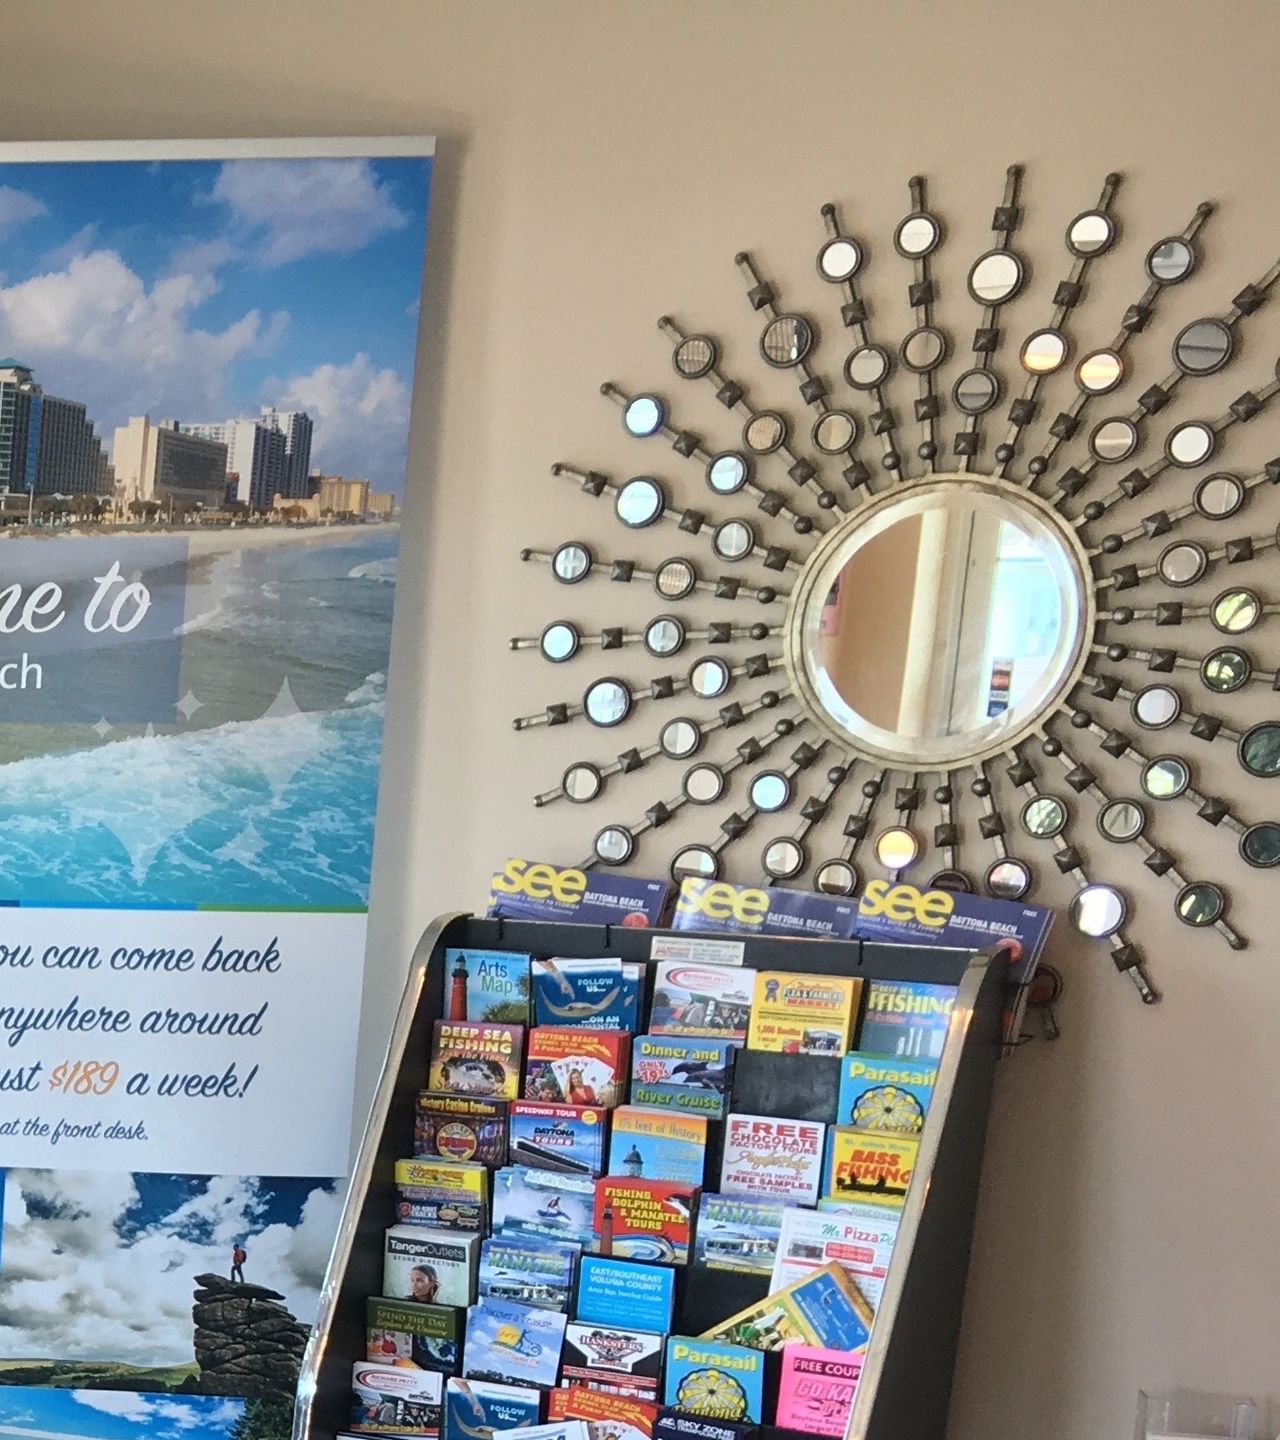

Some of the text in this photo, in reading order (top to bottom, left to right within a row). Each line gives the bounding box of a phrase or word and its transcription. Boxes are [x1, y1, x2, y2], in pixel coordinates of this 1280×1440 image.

[84, 560, 152, 633] to
[492, 858, 587, 904] see
[583, 891, 644, 907] DAYTONA BEACH
[677, 876, 770, 924] see
[858, 879, 955, 927] see
[767, 912, 833, 930] DAYTONA BEACH
[950, 915, 1018, 934] DAYTONA BEACH
[42, 945, 102, 969] can
[110, 947, 195, 971] come
[202, 935, 281, 972] back
[477, 960, 507, 977] Arts
[481, 976, 513, 995] Map
[577, 978, 614, 987] FOLLOW
[139, 1001, 268, 1035] around
[441, 1025, 513, 1042] DEEP SEA
[534, 1032, 599, 1045] DAYTONA BEACH
[440, 1038, 513, 1054] FISHING
[641, 1043, 719, 1061] Dinner and
[48, 1060, 120, 1095] $189
[126, 1072, 151, 1096] a
[157, 1062, 259, 1097] week!
[636, 1089, 721, 1109] River Cruise
[515, 1105, 554, 1116] SPEEDWAY
[555, 1108, 577, 1118] TOUR
[0, 1118, 20, 1136] at
[22, 1116, 49, 1137] the
[51, 1118, 102, 1145] front
[104, 1120, 149, 1141] desk.
[534, 1127, 575, 1137] DAYTONA
[730, 1120, 819, 1140] FREE
[534, 1136, 573, 1146] TOURS
[730, 1132, 818, 1149] CHOCOLATE
[730, 1140, 818, 1155] FACTORY TOURS
[850, 1149, 901, 1167] BASS
[736, 1169, 773, 1179] CHOCOLATE
[836, 1162, 912, 1184] FISHING
[726, 1174, 813, 1191] FREE SAMPLES
[605, 1187, 651, 1200] FISHING
[612, 1198, 662, 1210] DOLPHIN
[620, 1208, 685, 1223] & MANATEE
[625, 1218, 662, 1230] TOURS
[844, 1226, 879, 1243] Pizza
[390, 1239, 466, 1259] TangerOutlets
[419, 1257, 461, 1268] DIRECTORY
[590, 1266, 663, 1283] EAST/SOUTHEAST
[590, 1275, 662, 1292] VOLUSIA COUNTY
[428, 1318, 447, 1328] DAY
[672, 1344, 756, 1371] Parasail
[794, 1360, 823, 1373] FREE
[490, 1404, 526, 1415] FOLLOW
[613, 1398, 642, 1411] BEACH
[677, 1419, 736, 1438] SKY ZONE
